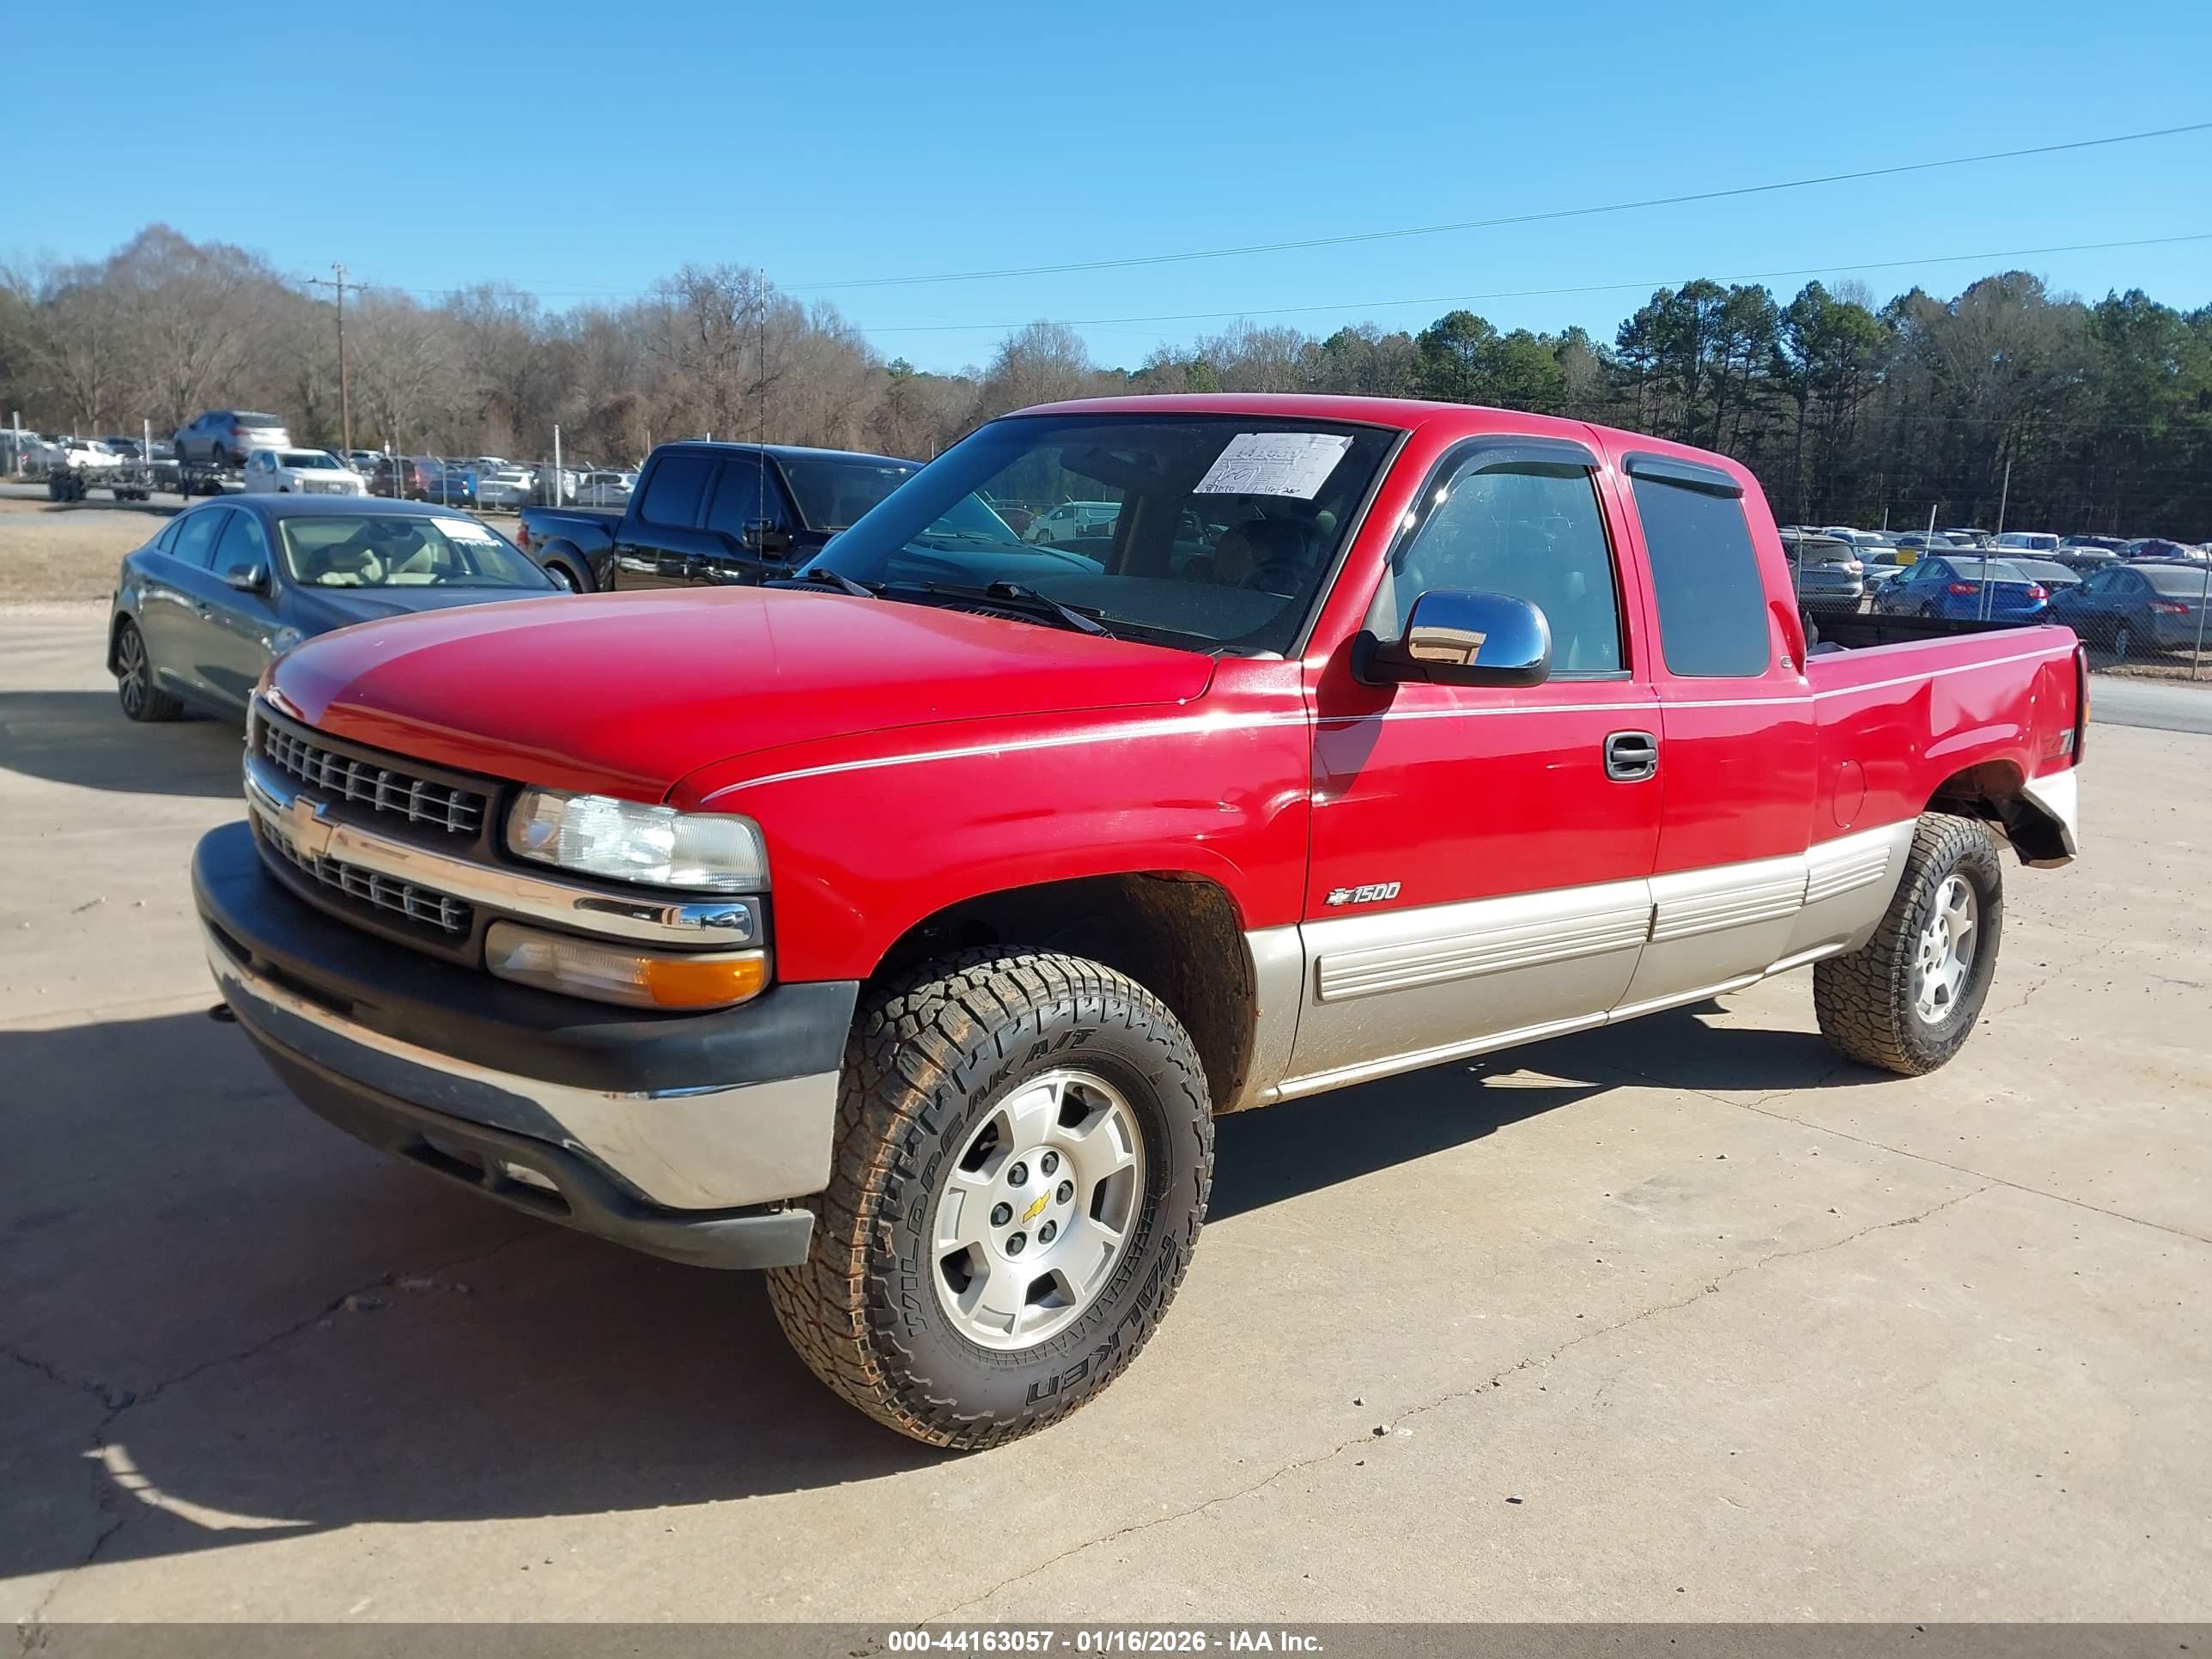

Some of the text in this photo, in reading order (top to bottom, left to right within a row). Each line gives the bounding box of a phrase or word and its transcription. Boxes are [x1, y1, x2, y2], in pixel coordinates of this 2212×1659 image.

[1353, 882, 1401, 902] 1500
[901, 1055, 1018, 1337] WILDPEAK
[1025, 1229, 1178, 1406] FALKEN
